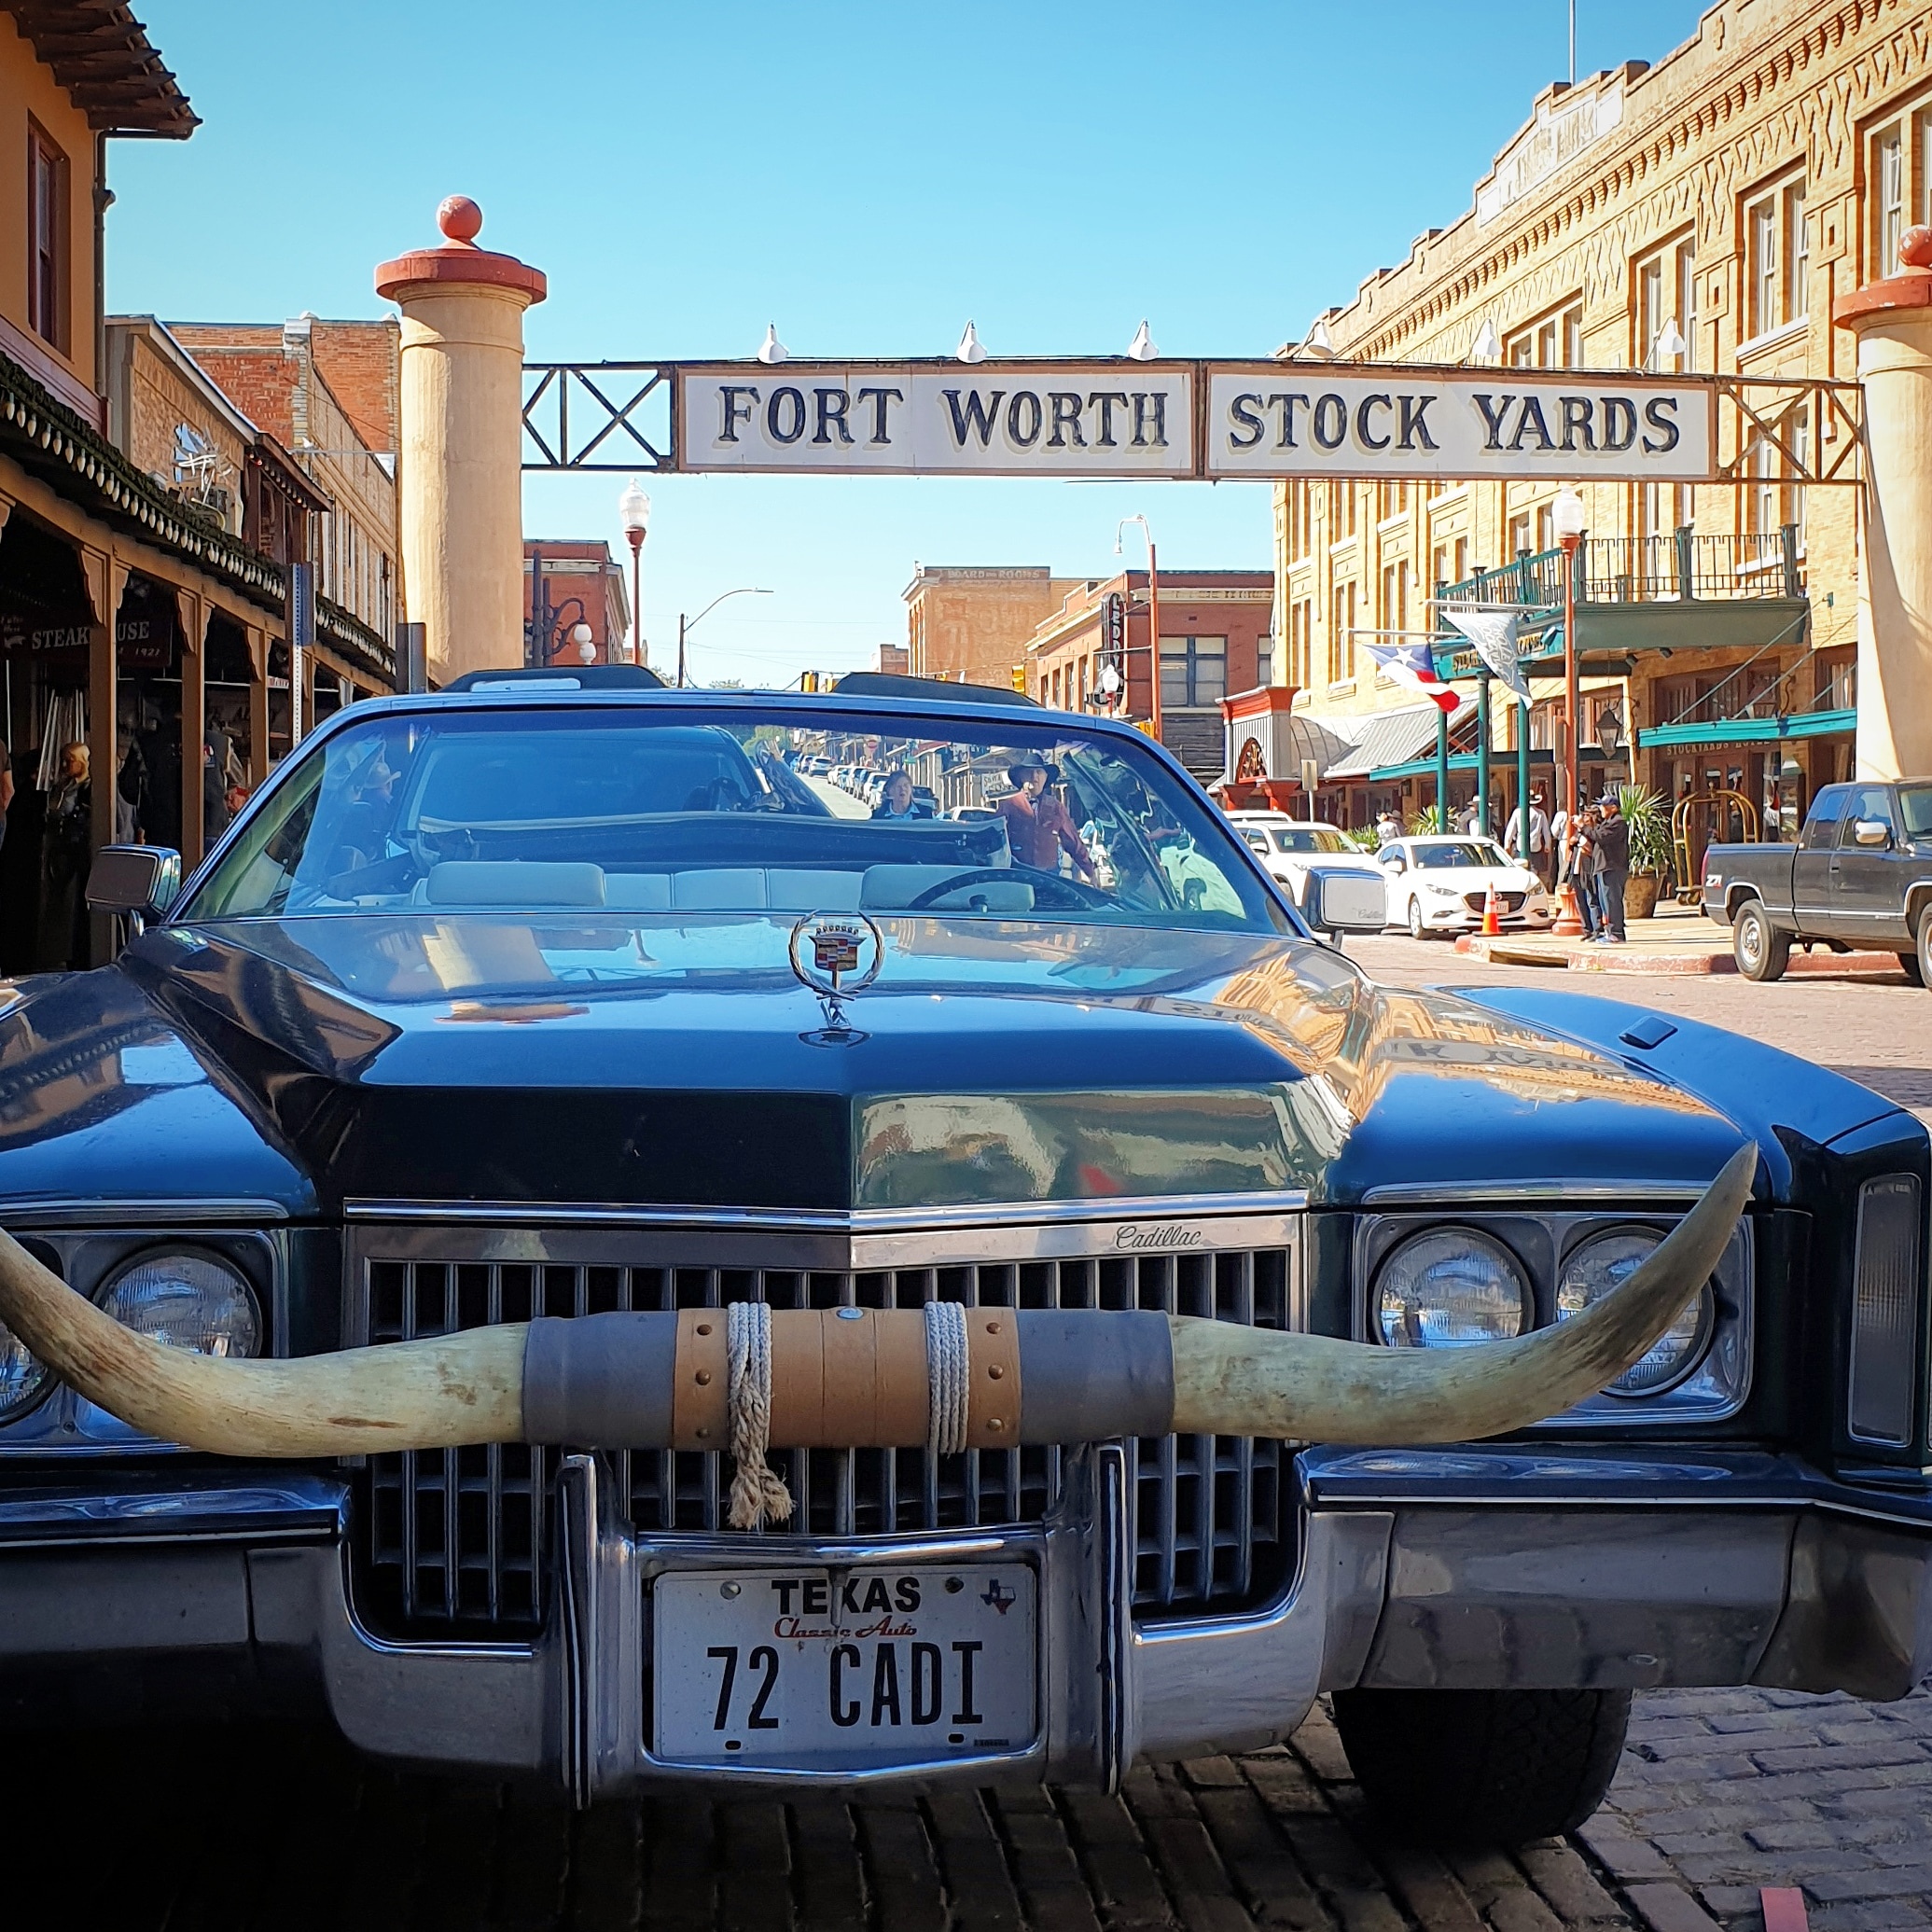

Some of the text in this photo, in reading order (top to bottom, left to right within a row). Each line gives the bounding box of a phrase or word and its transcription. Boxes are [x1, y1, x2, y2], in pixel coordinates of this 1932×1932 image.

[719, 386, 1680, 453] FORT WORTH STOCK YARDS
[948, 570, 985, 578] BOARD
[1116, 1225, 1202, 1249] Cadillac
[771, 1577, 921, 1615] TEXAS
[855, 1615, 917, 1638] Auto
[707, 1640, 983, 1730] 72 CADI
